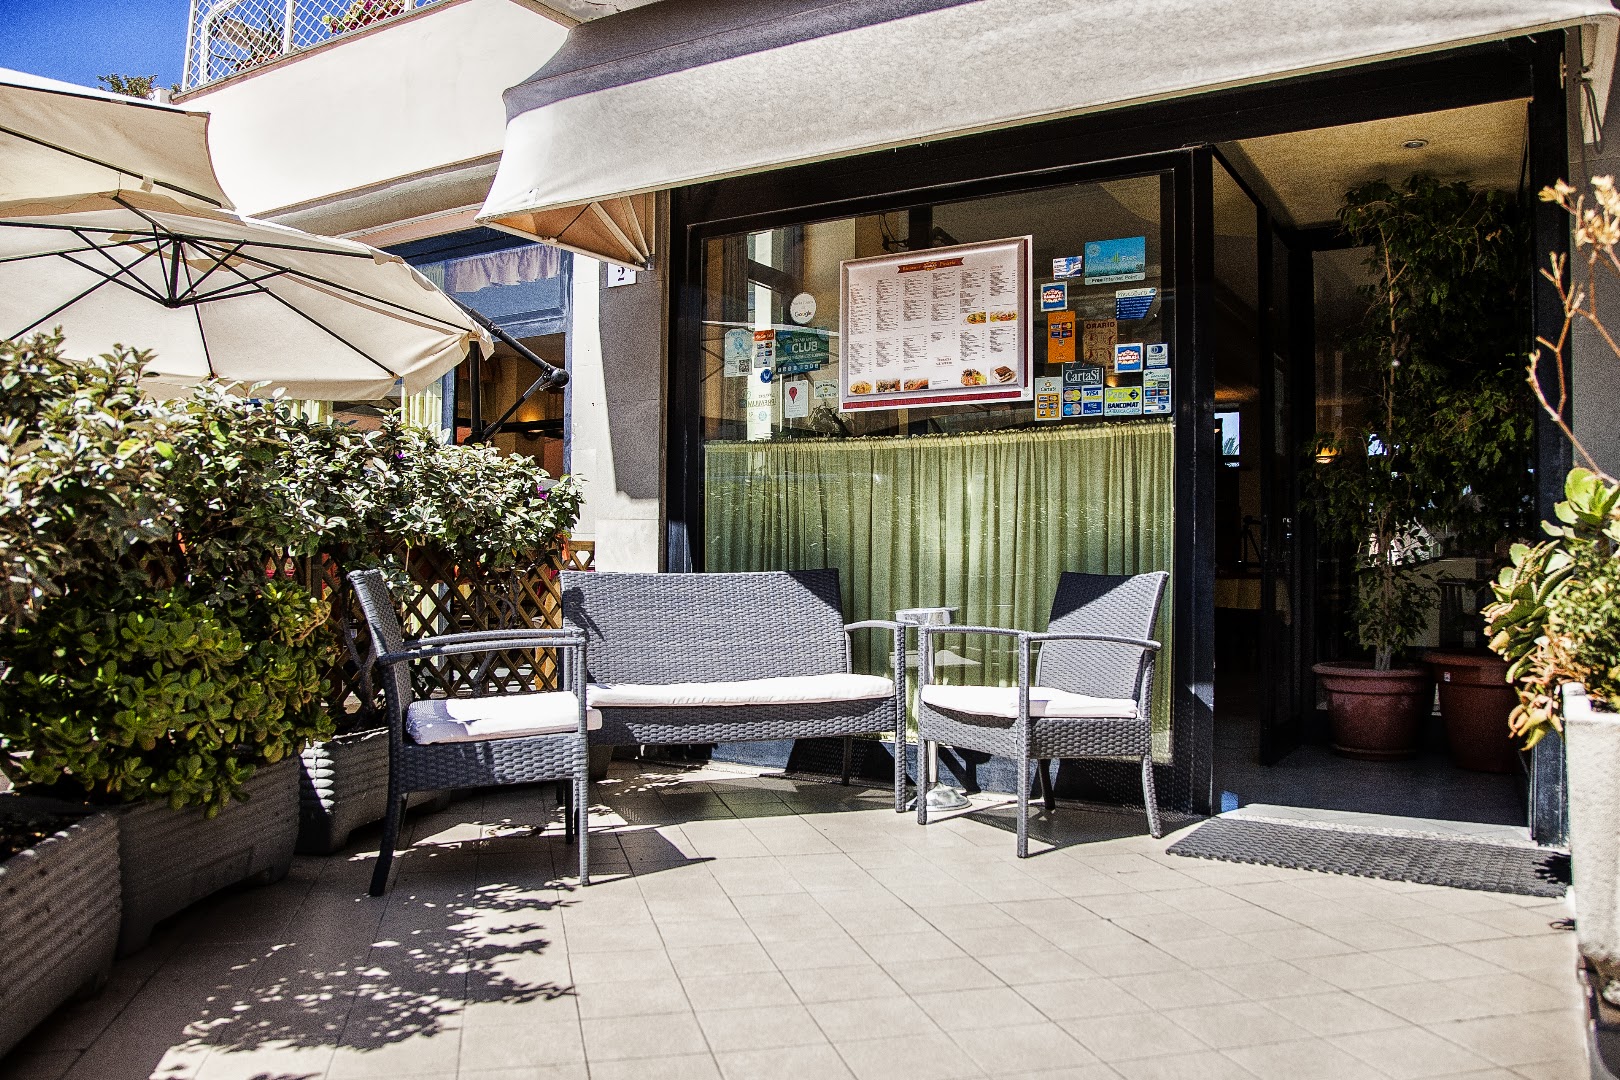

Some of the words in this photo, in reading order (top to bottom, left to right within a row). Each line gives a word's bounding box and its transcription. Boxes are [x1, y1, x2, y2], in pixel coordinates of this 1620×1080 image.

[617, 267, 625, 281] 2
[794, 310, 813, 318] Google
[1086, 322, 1115, 330] ORARIO
[792, 341, 818, 353] CLUB
[1065, 369, 1100, 383] CartaSi
